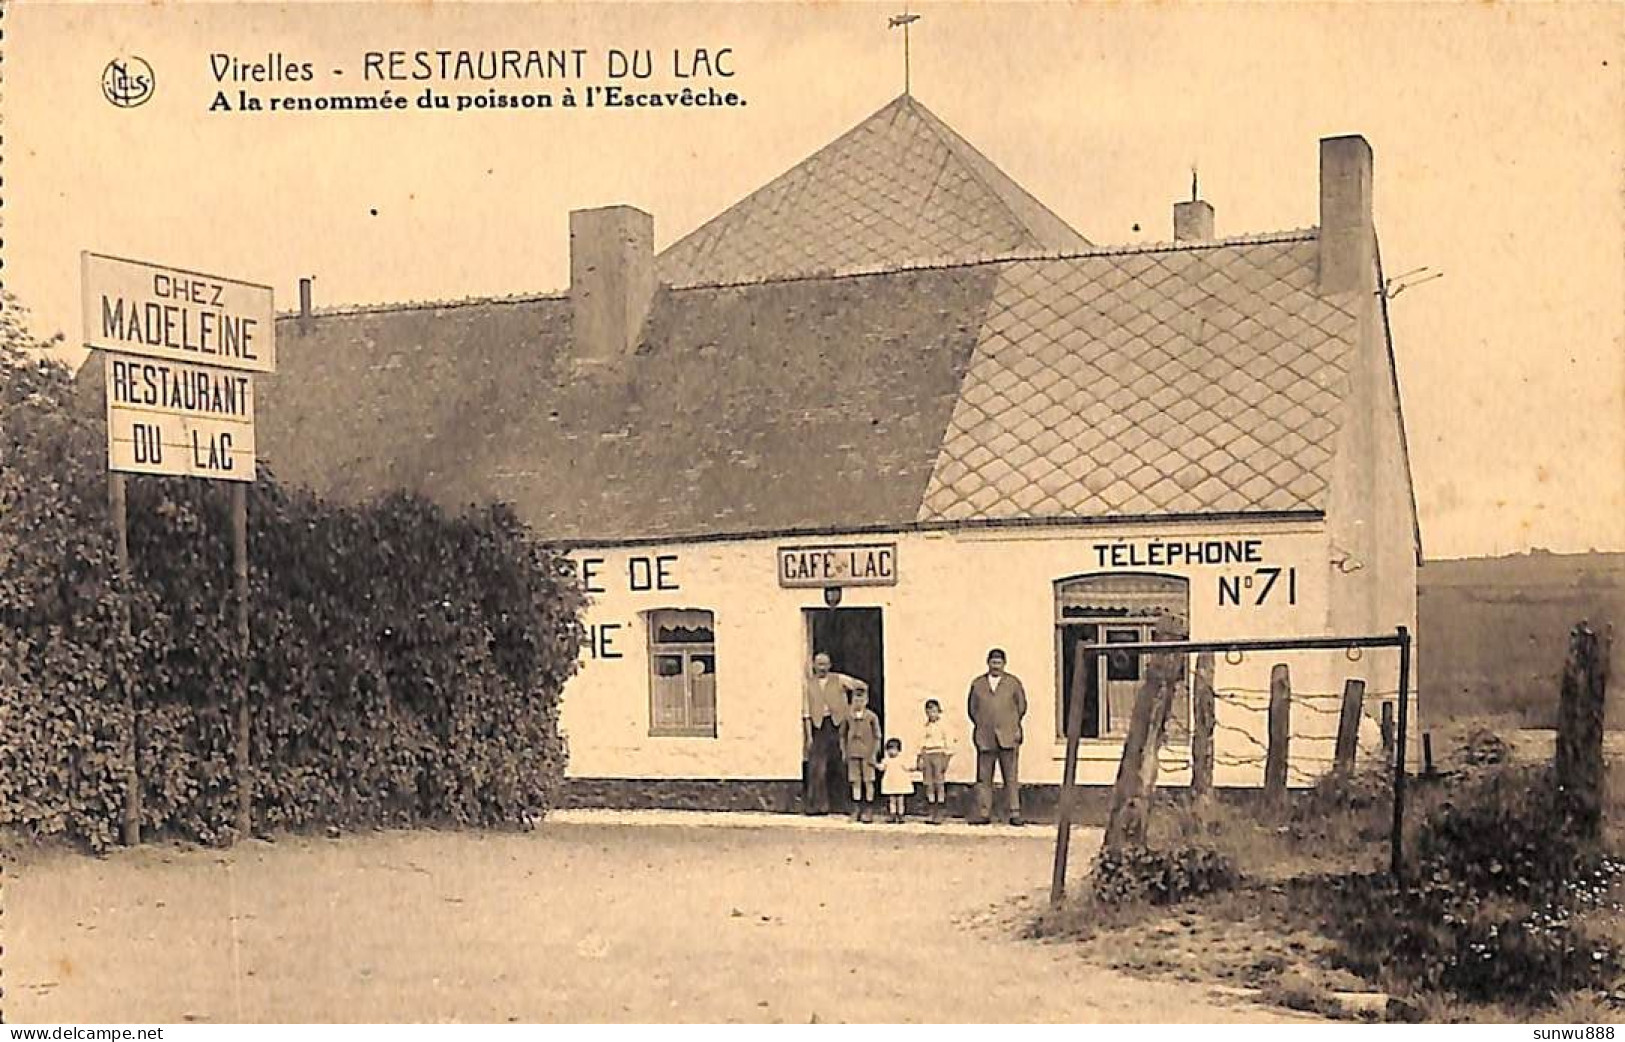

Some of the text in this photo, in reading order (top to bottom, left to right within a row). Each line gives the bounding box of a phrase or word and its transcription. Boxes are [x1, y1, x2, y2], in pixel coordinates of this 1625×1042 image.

[154, 273, 225, 308] CHEZ
[102, 294, 258, 361] MADELEINE
[113, 360, 249, 417] RESTAURANT
[133, 423, 233, 471] DU LAC
[784, 551, 835, 578] CAFÉ
[851, 551, 891, 578] LAC
[1093, 537, 1263, 567] TÉLÉPHONE
[630, 555, 680, 592] DE
